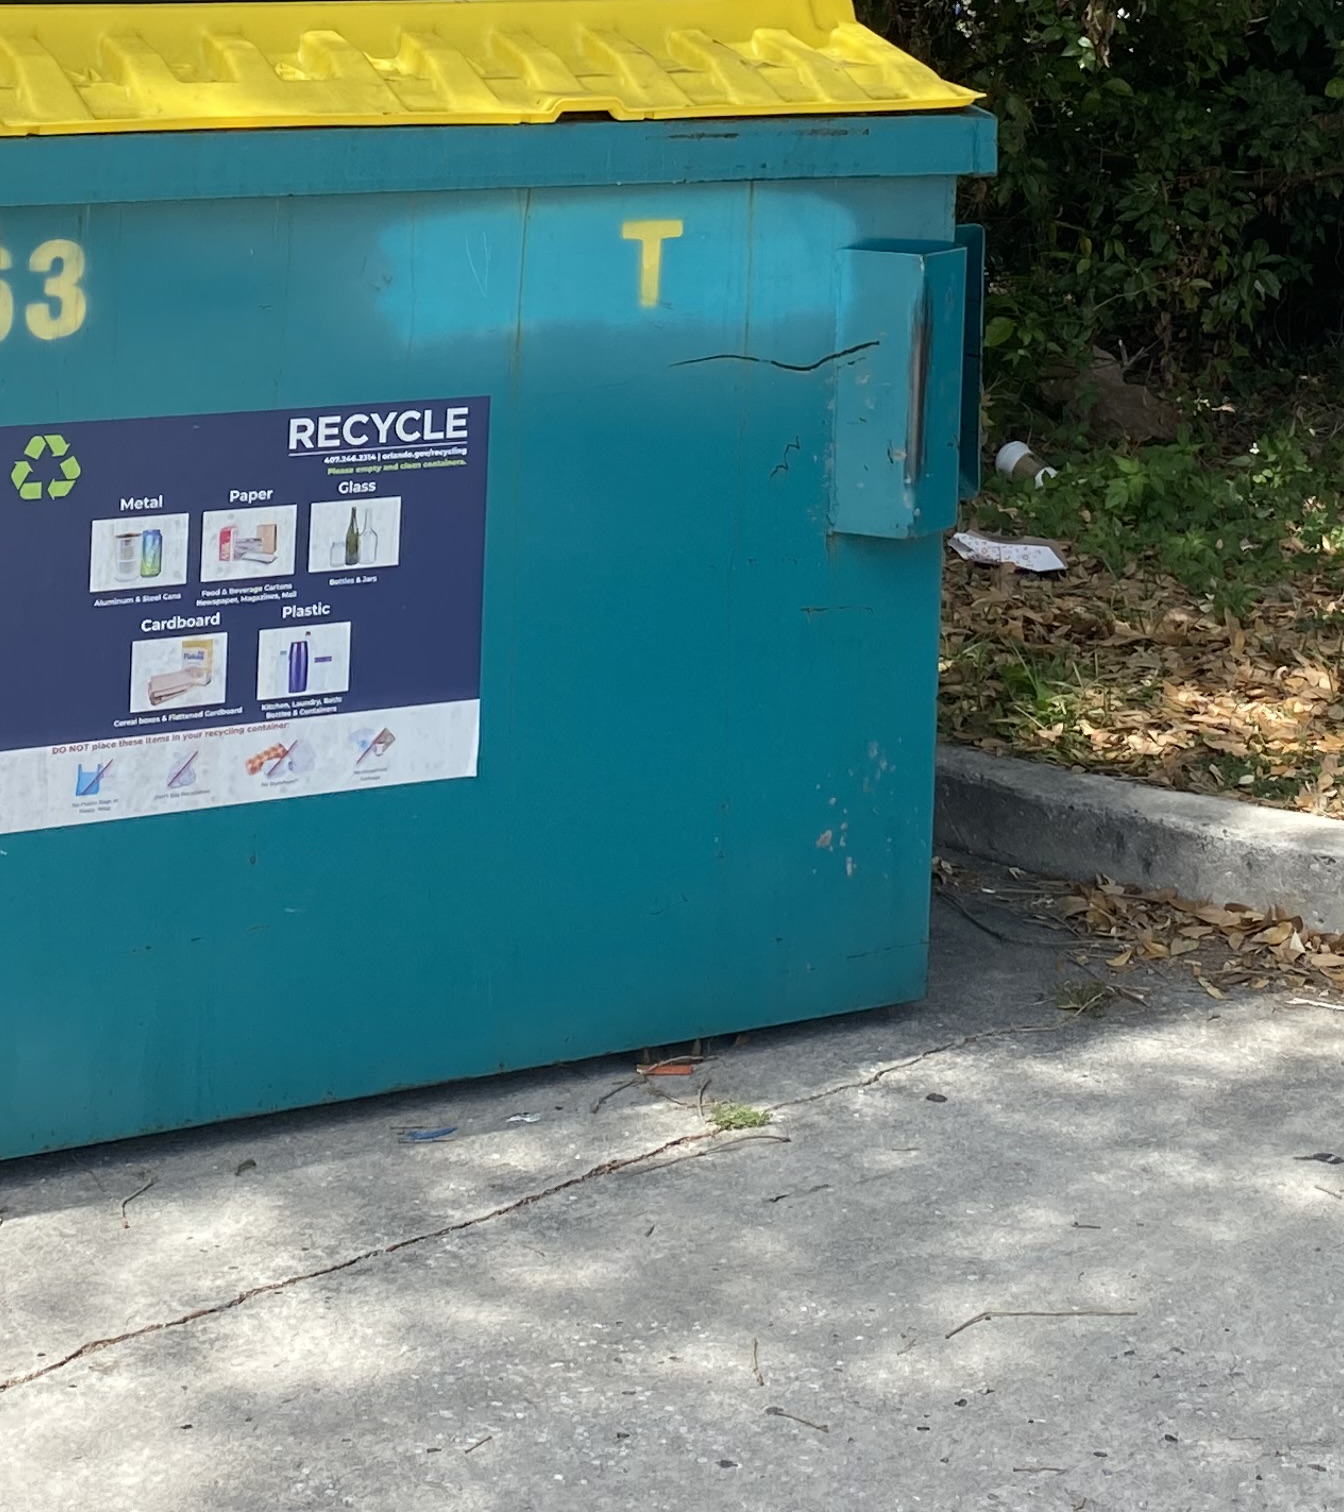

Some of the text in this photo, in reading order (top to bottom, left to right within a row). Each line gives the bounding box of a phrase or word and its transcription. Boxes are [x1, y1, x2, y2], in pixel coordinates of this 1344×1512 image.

[622, 219, 684, 308] T
[288, 406, 469, 450] RECYCLE
[383, 462, 399, 472] and
[338, 480, 377, 495] Glass
[120, 495, 164, 512] Metal
[229, 488, 274, 505] Paper
[94, 597, 134, 607] Aluminum
[163, 592, 182, 601] Cans
[201, 588, 221, 598] Food
[282, 602, 331, 619] Plastic
[140, 612, 221, 633] Cardboard
[52, 723, 290, 755] DO NOT place these items in your recycling container:
